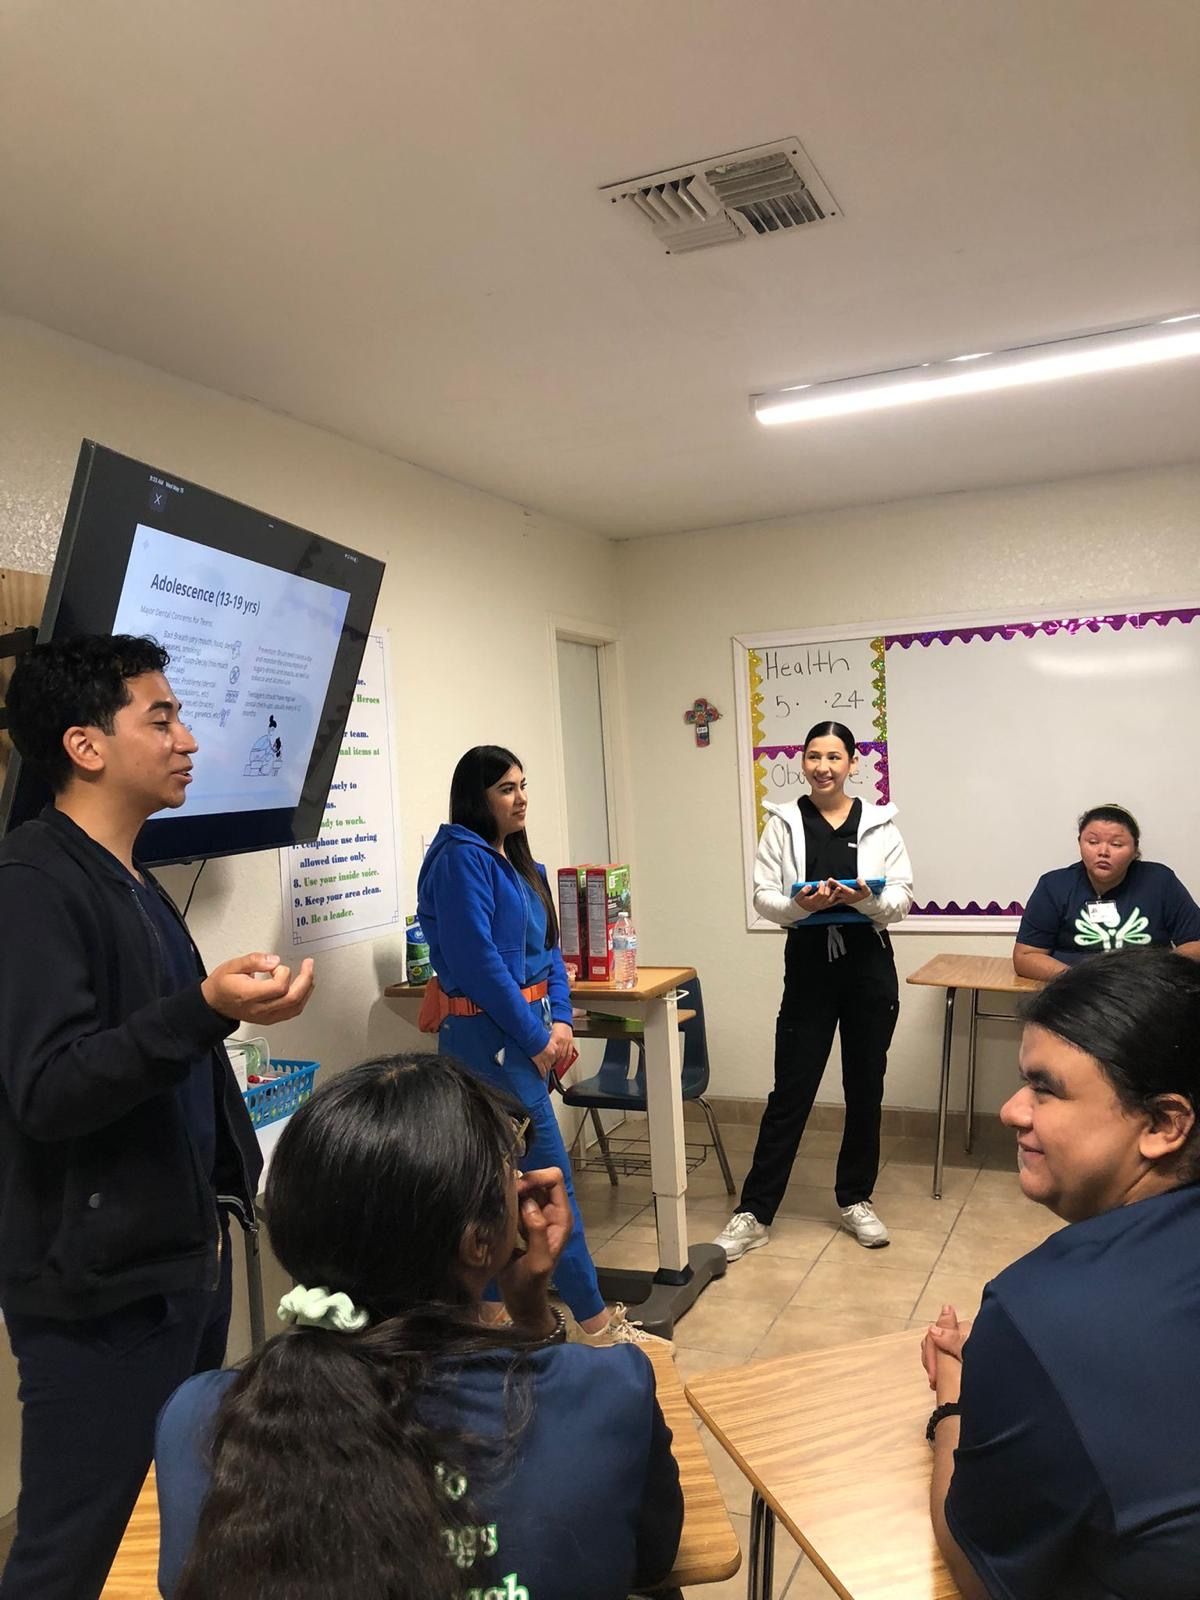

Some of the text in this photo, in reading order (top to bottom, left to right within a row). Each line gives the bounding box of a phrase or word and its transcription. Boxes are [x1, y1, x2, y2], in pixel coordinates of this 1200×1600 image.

[150, 574, 260, 616] Adolescence (13-19 yrs)
[140, 605, 154, 616] Major
[155, 607, 171, 619] Dental
[765, 650, 850, 680] Health
[356, 693, 380, 704] Heroes
[349, 730, 369, 739] team.
[353, 747, 371, 756] items
[336, 819, 343, 827] to
[345, 816, 366, 825] work.
[340, 836, 353, 844] use
[354, 833, 377, 843] during
[300, 852, 366, 868] allowed time only.
[293, 868, 379, 888] 8. Use your inside voice.
[294, 886, 382, 908] 9. Keep your area clean.
[296, 916, 309, 927] 10.
[311, 914, 322, 924] Be
[329, 908, 354, 921] leader.
